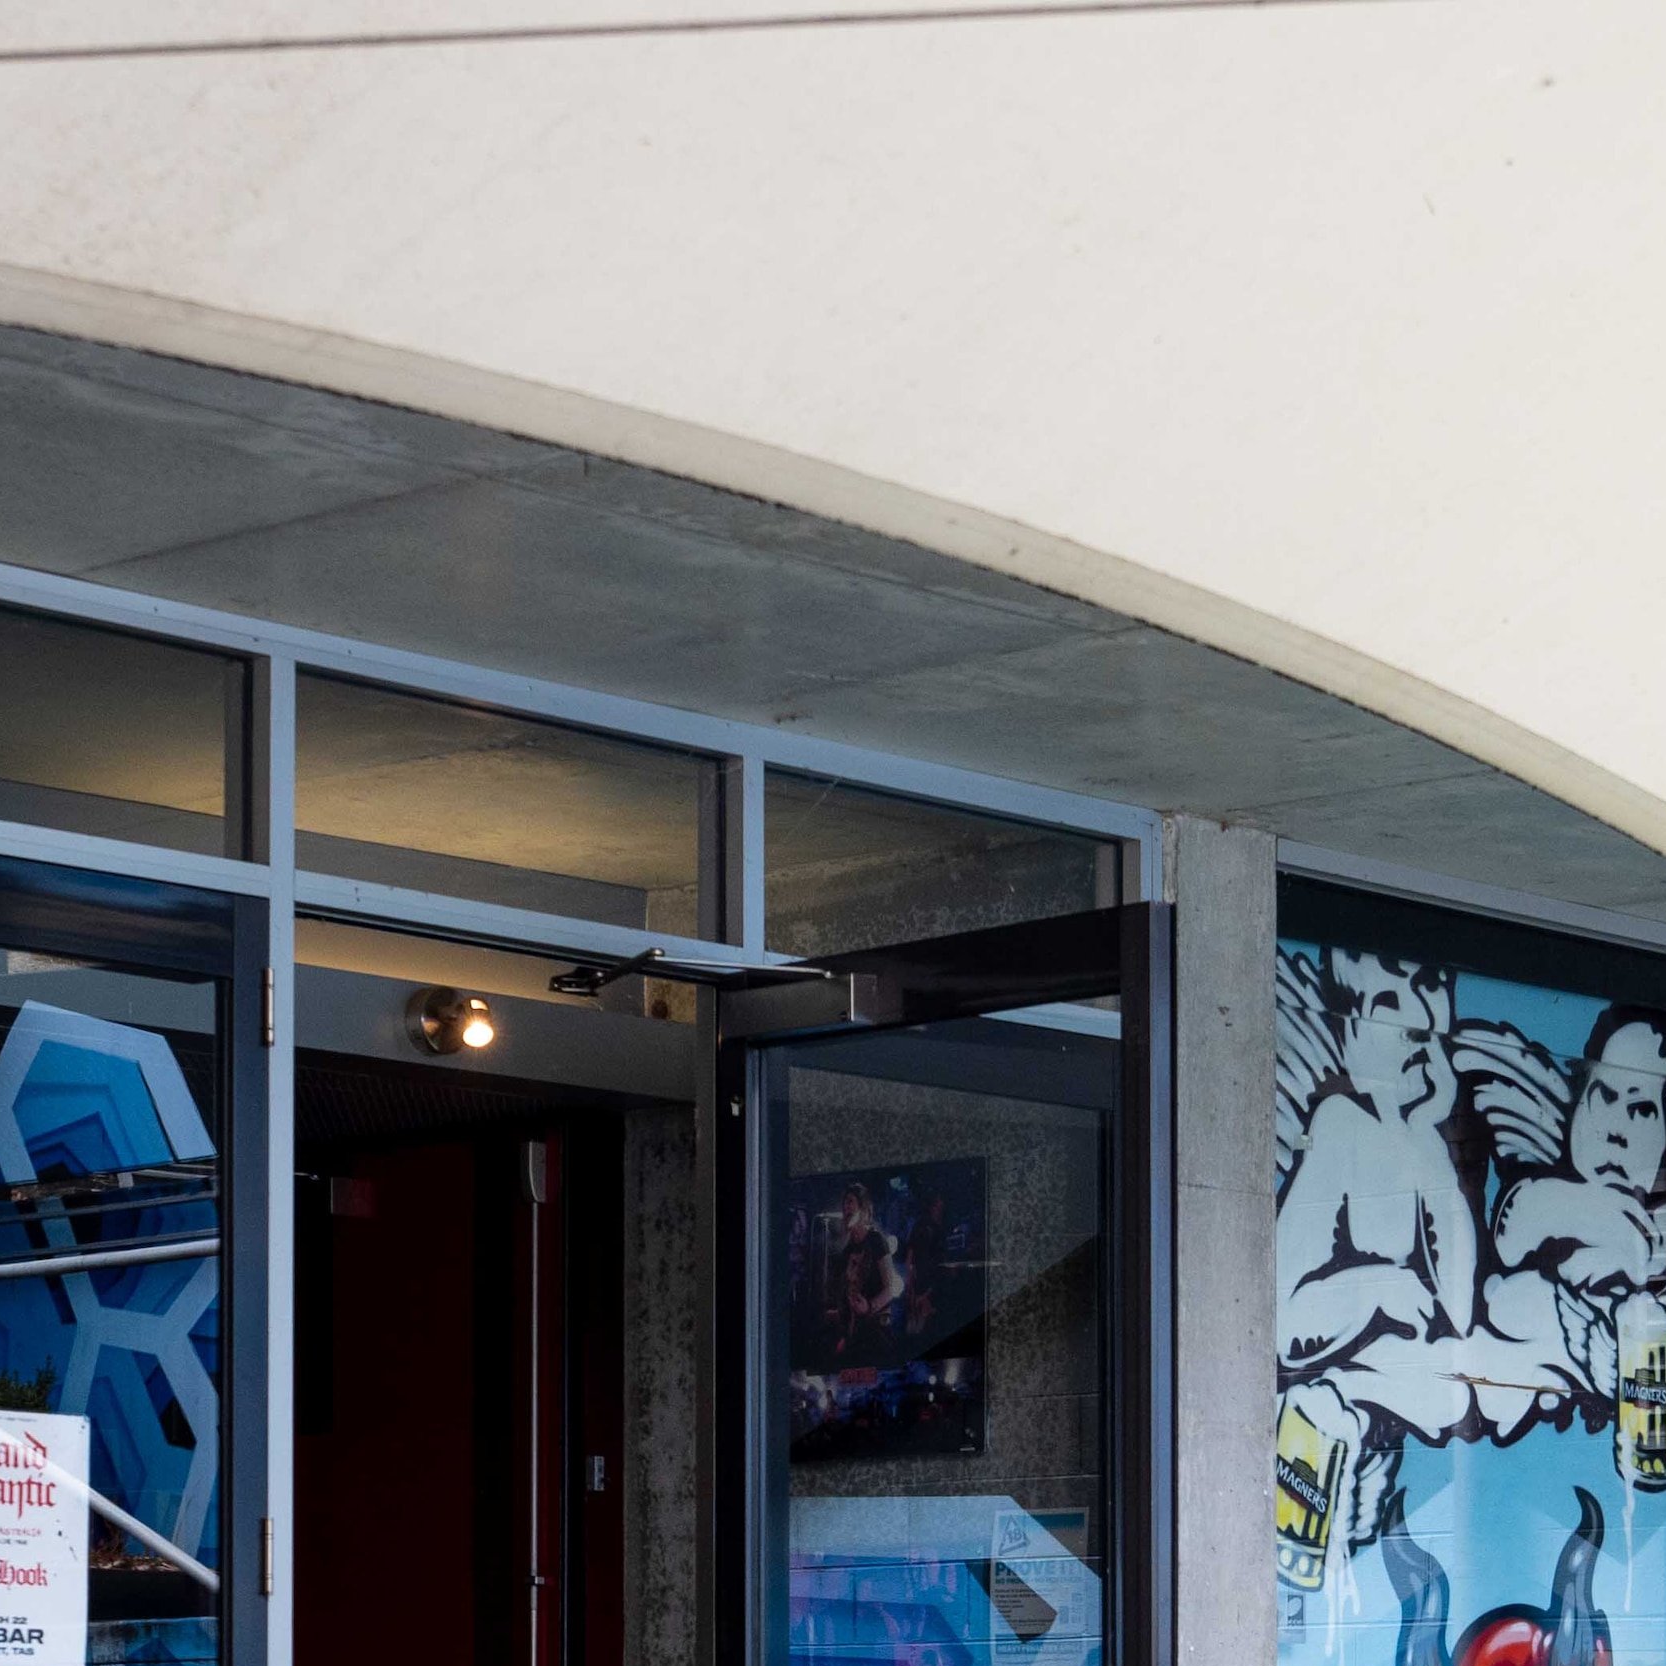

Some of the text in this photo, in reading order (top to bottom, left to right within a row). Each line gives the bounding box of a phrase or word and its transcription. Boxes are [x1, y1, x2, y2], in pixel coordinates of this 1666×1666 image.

[1277, 1459, 1328, 1514] MAGNERS
[12, 1616, 28, 1625] 22
[12, 1647, 35, 1656] TAS
